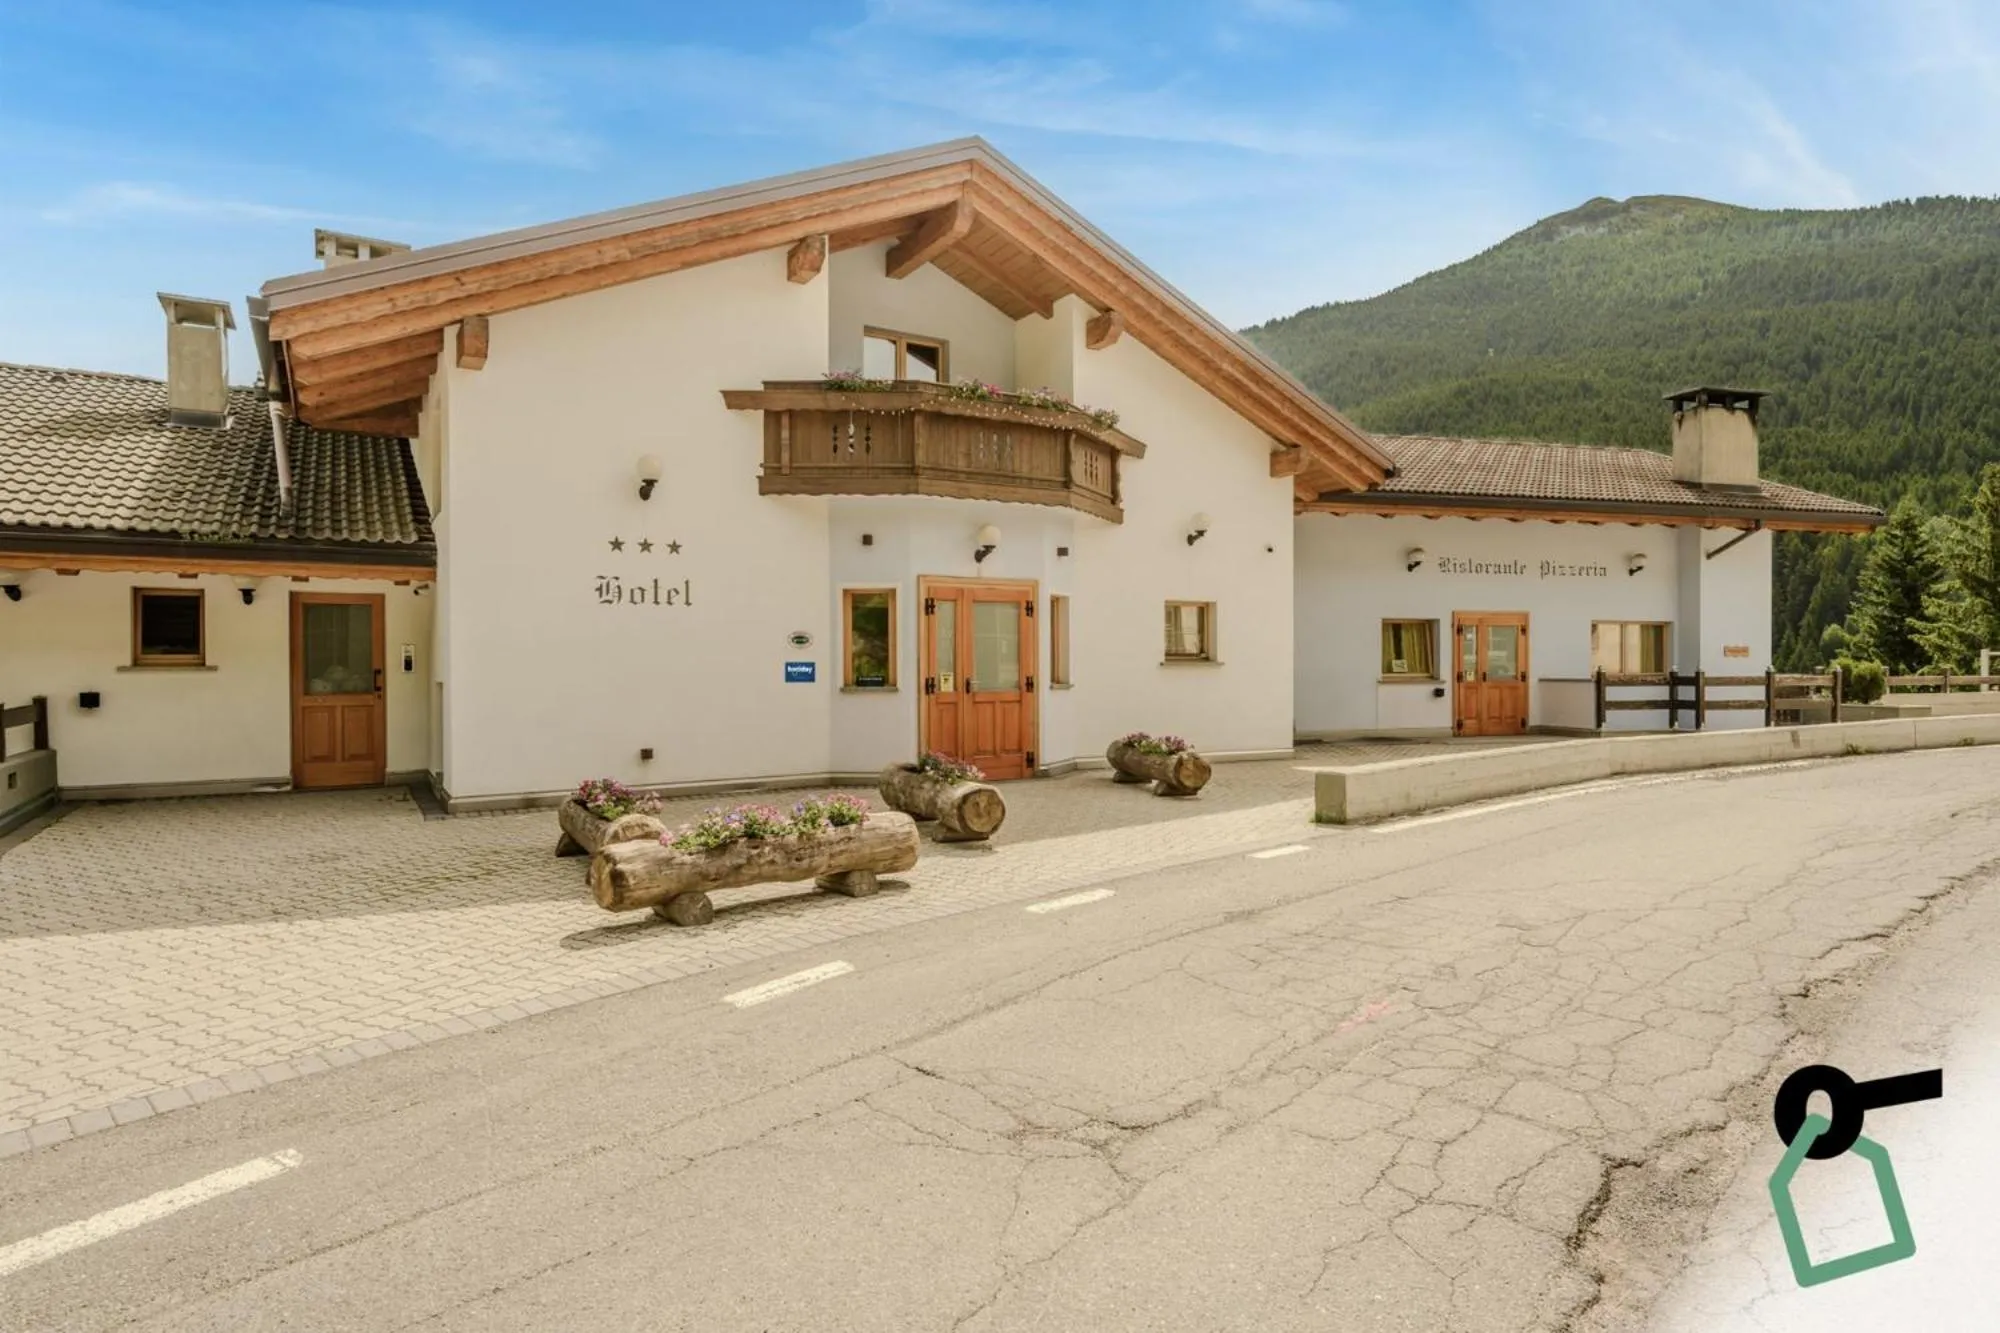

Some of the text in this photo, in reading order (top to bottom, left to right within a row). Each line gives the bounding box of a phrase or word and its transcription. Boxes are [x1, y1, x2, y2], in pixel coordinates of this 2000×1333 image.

[1438, 556, 1607, 580] Ristorante Pizzeria
[594, 575, 693, 607] Hotel
